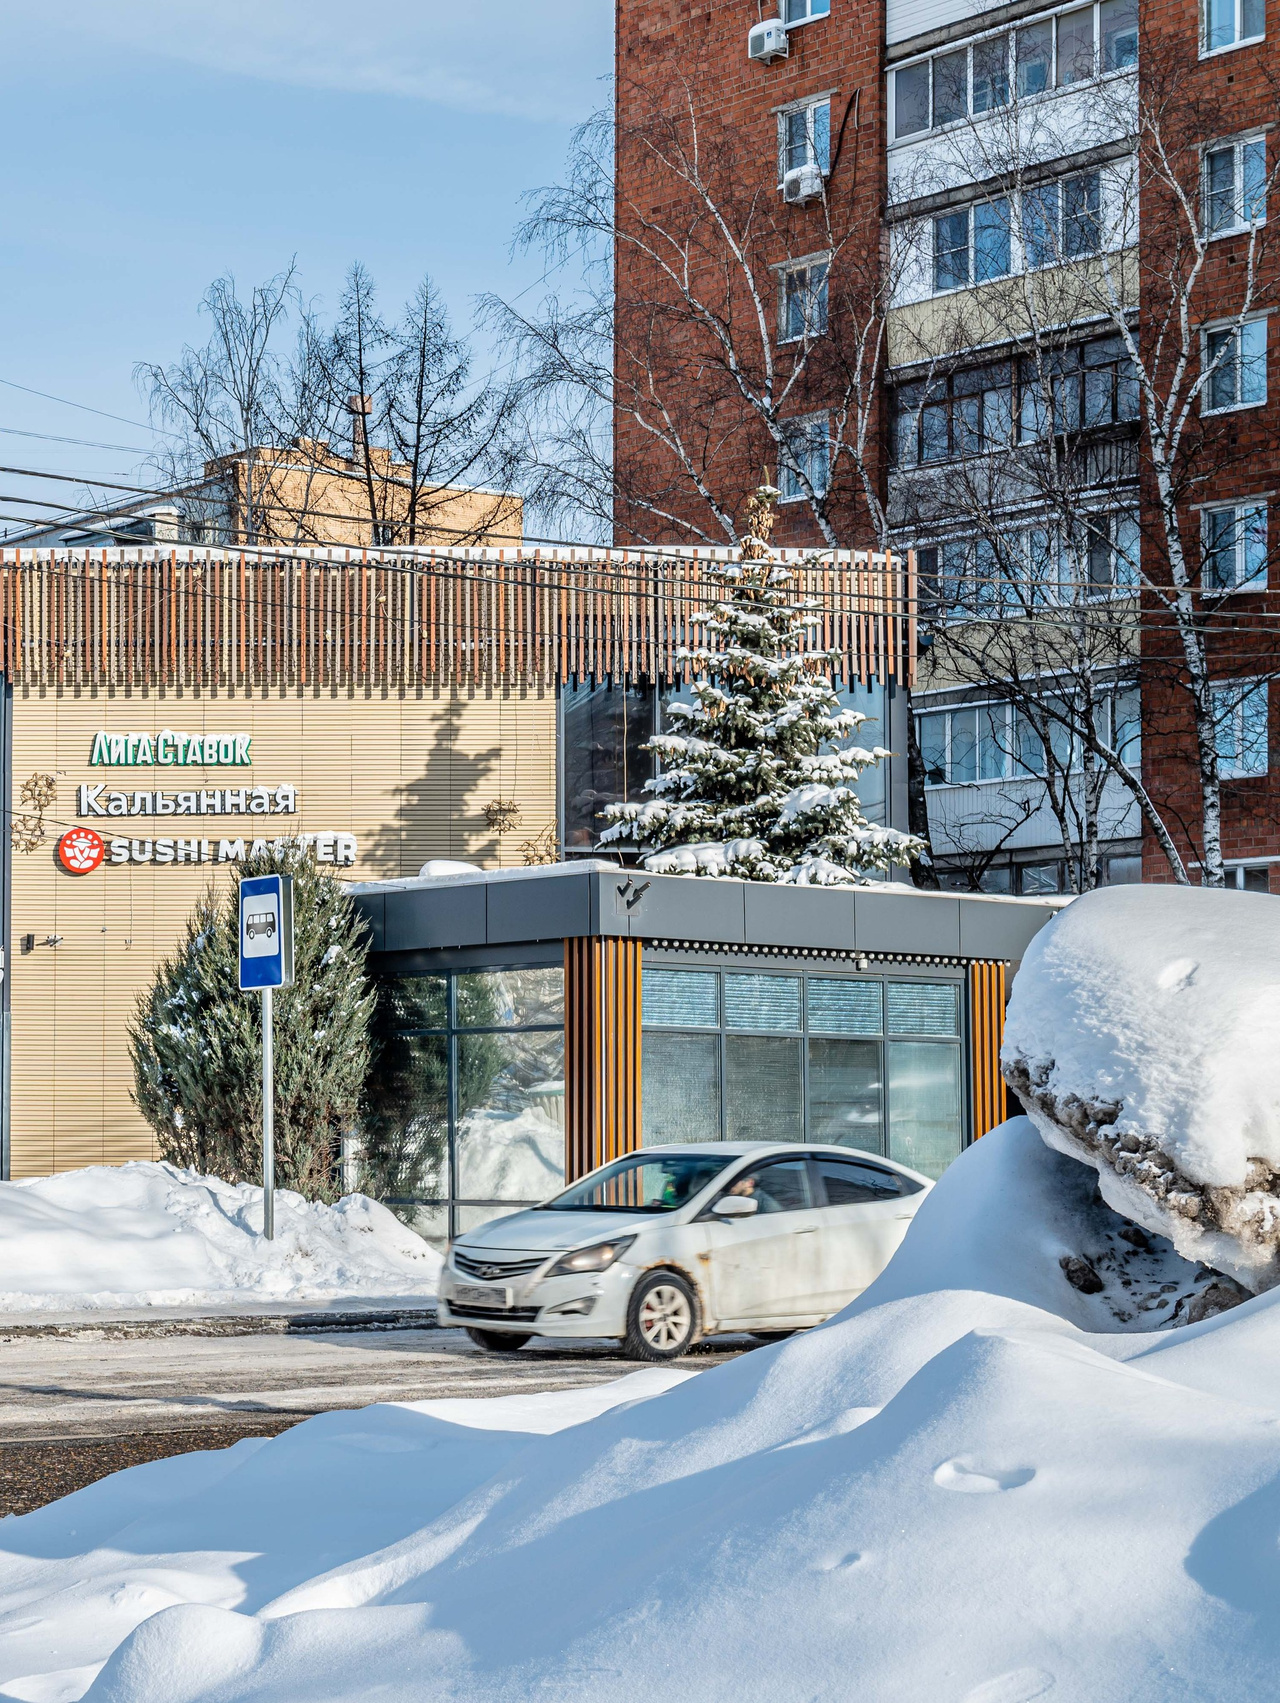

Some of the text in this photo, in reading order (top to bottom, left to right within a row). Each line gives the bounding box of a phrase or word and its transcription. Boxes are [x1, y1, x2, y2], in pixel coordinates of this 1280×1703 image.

[79, 784, 298, 816] Кальянная
[109, 835, 358, 864] SUSHI MATER
